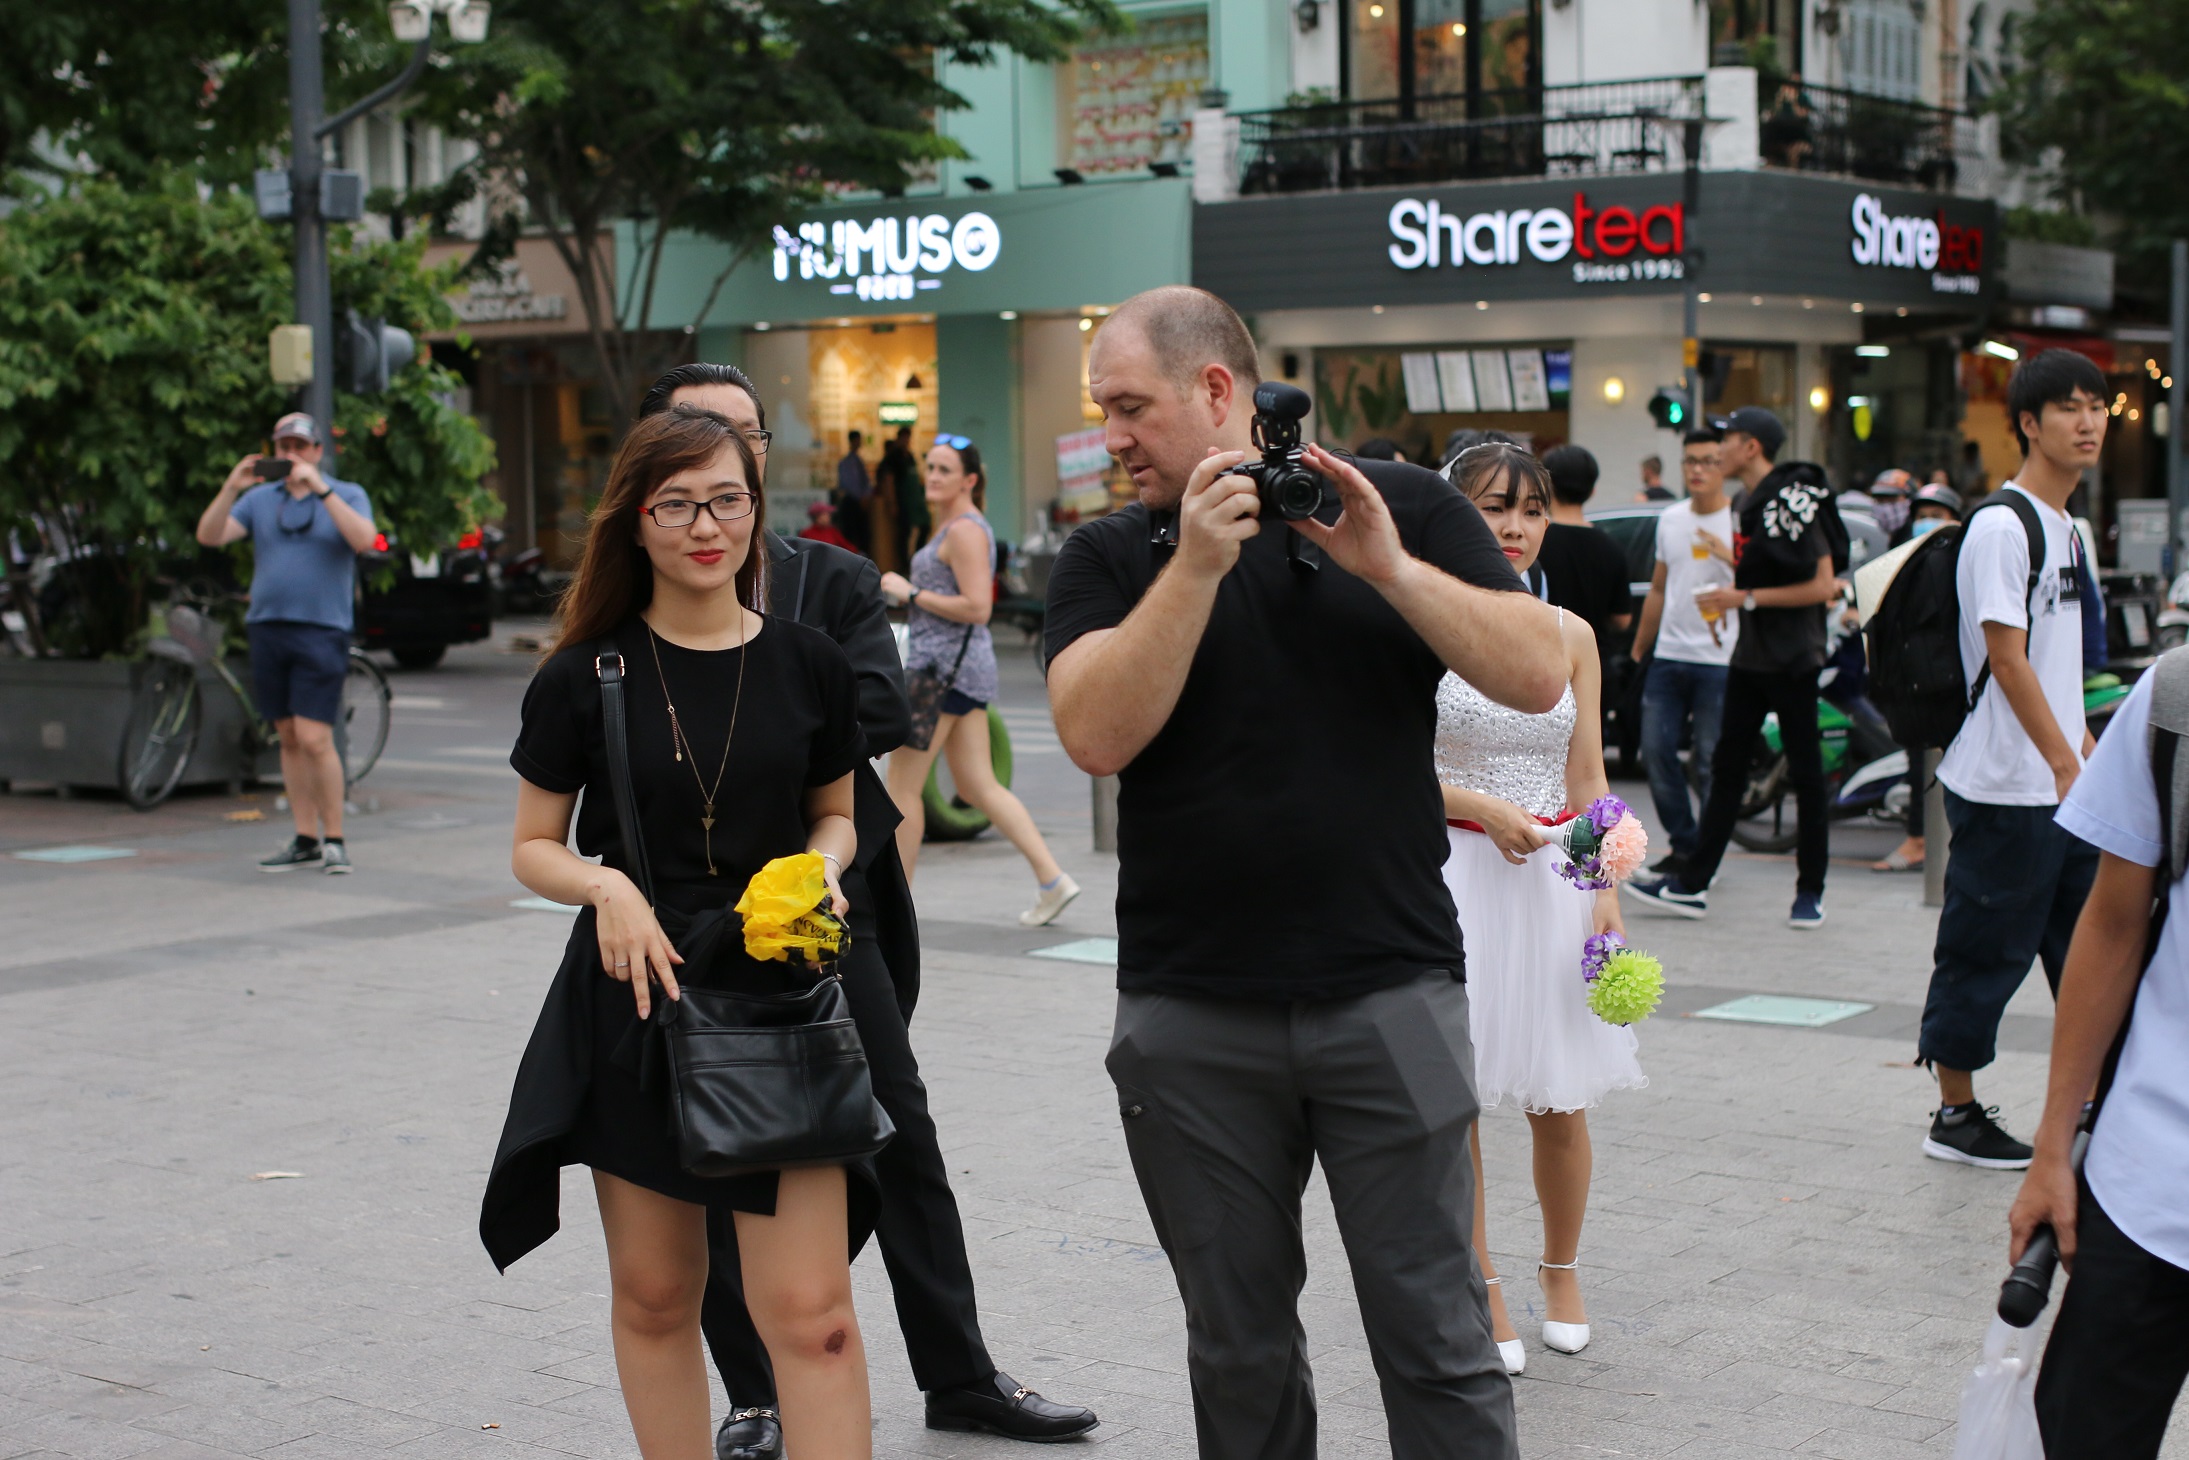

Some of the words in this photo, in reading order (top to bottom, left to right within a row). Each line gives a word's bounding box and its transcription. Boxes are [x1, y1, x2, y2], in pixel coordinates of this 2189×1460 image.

[1388, 192, 1684, 270] Sharetea
[1851, 193, 1983, 272] Sharetea
[1573, 262, 1630, 283] Since
[1631, 258, 1685, 280] 1992
[1248, 463, 1266, 471] SONY
